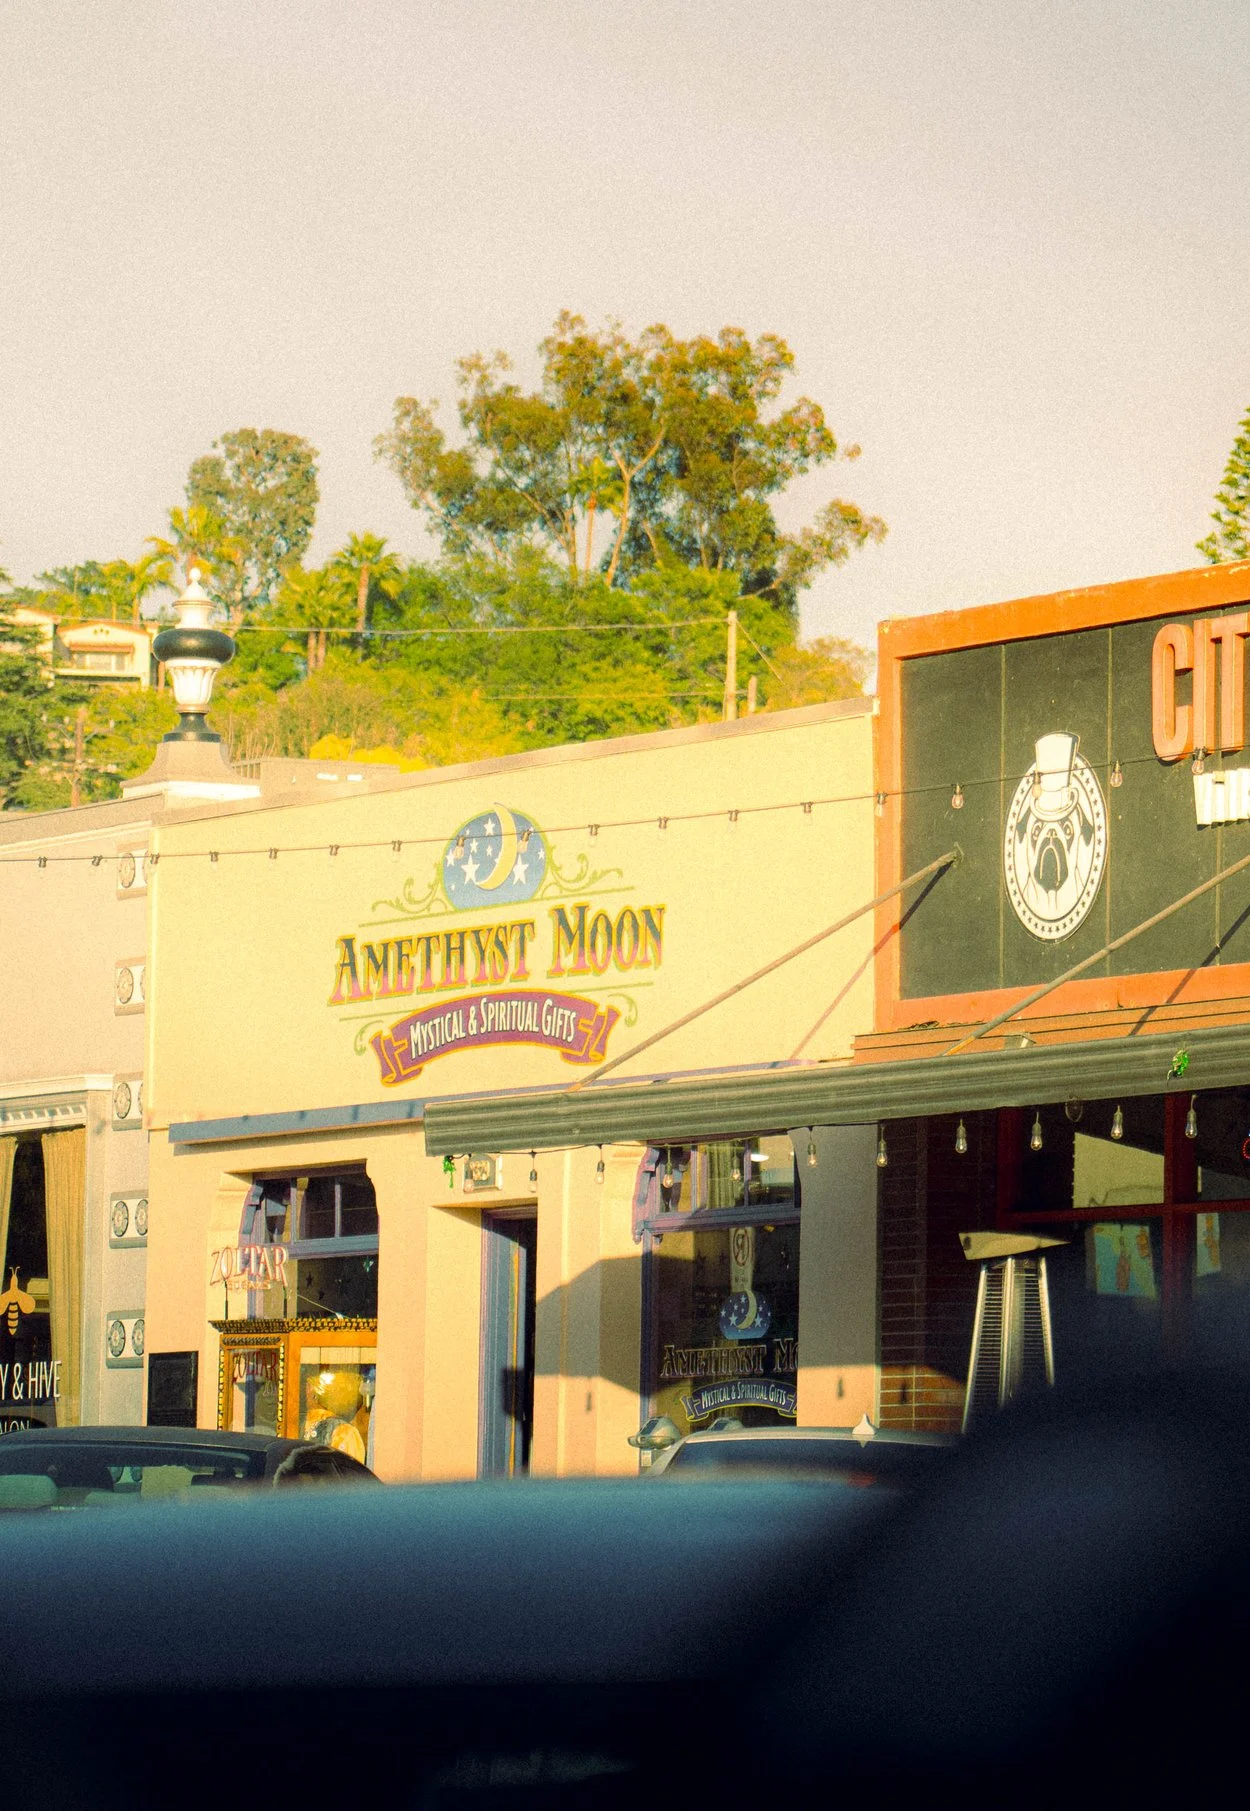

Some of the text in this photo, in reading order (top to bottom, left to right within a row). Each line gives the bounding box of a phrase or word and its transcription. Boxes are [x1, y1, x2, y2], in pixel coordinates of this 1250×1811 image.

[328, 902, 665, 1005] AMETHYST MOON
[410, 997, 576, 1060] MYSTICAL & SPIRITUAL GIFTS
[210, 1244, 288, 1288] ZOLTAR
[12, 1362, 23, 1400] &
[28, 1360, 62, 1399] HIVE
[660, 1344, 767, 1378] AMETHYST
[702, 1391, 729, 1409] MYSTICAL
[769, 1384, 787, 1405] GIFTS
